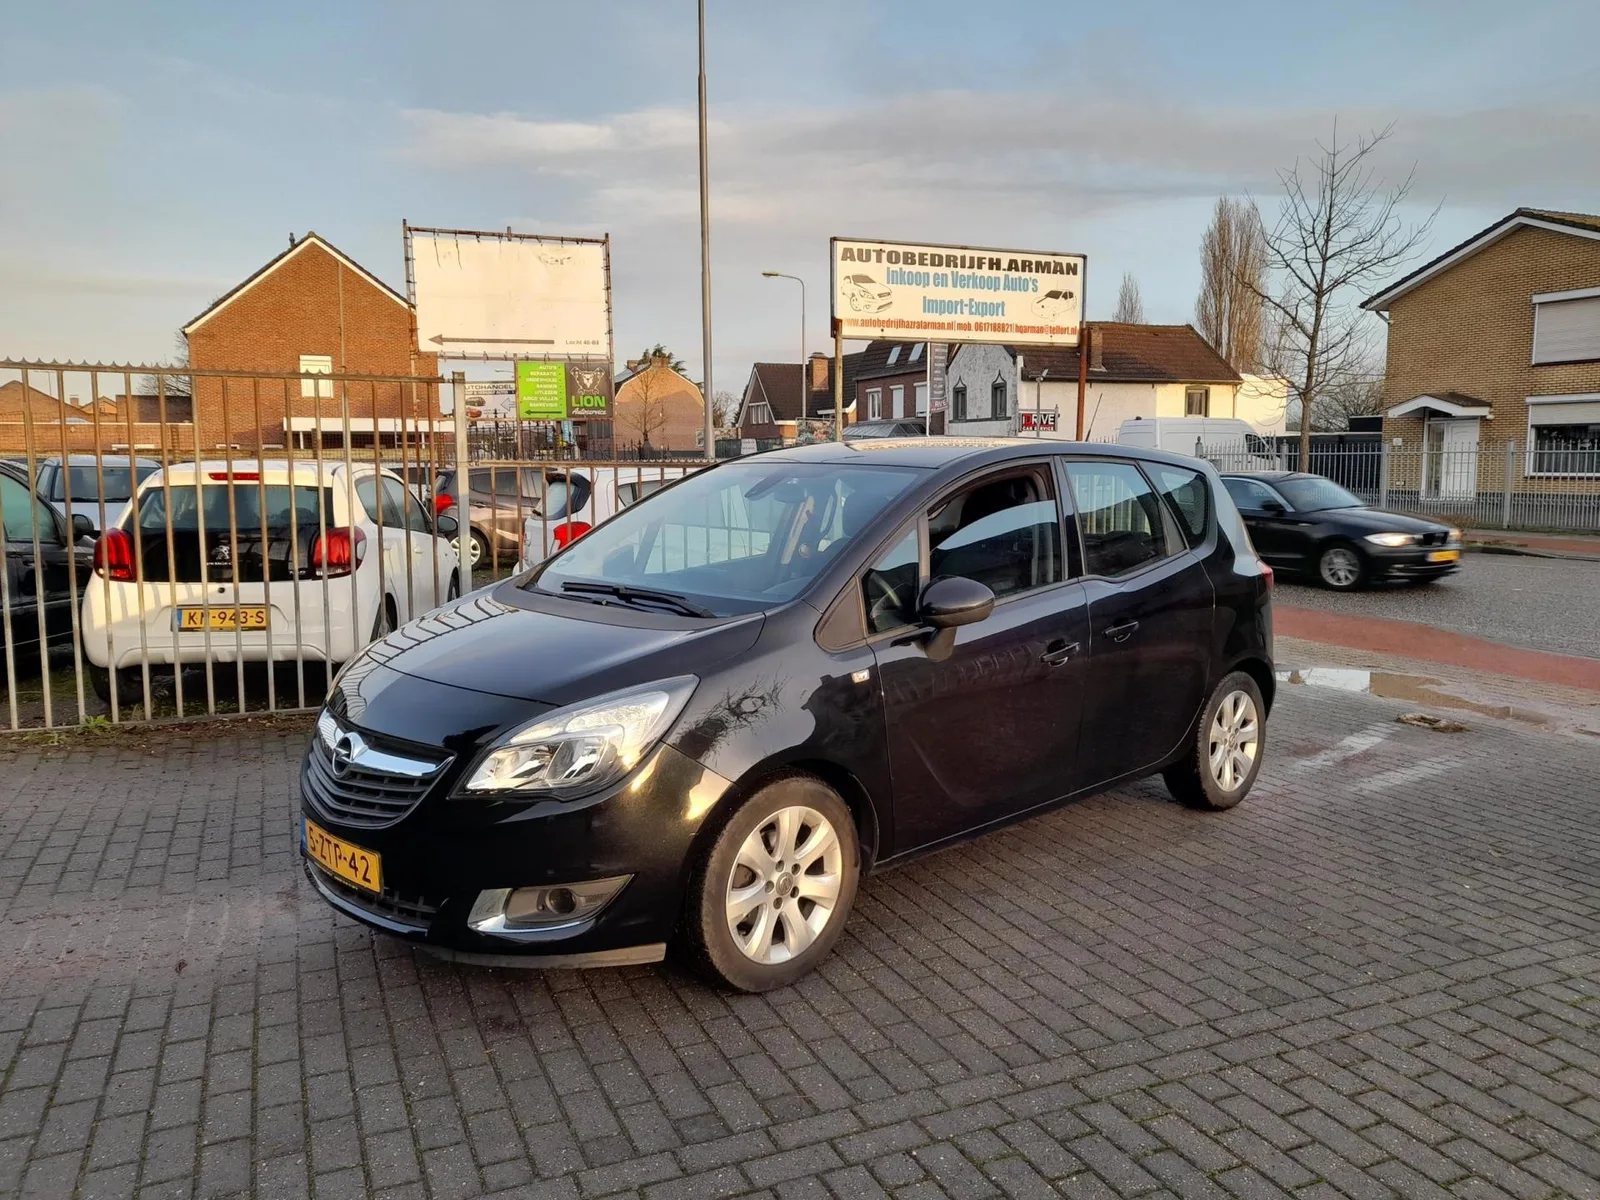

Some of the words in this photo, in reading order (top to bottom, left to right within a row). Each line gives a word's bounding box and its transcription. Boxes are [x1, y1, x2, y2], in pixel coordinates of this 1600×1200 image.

[886, 267, 930, 288] Inkoop
[933, 272, 949, 287] en
[951, 270, 1001, 293] Verkoop
[1003, 274, 1039, 293] Auto's
[922, 295, 1006, 318] Import-Export
[571, 395, 606, 408] LION
